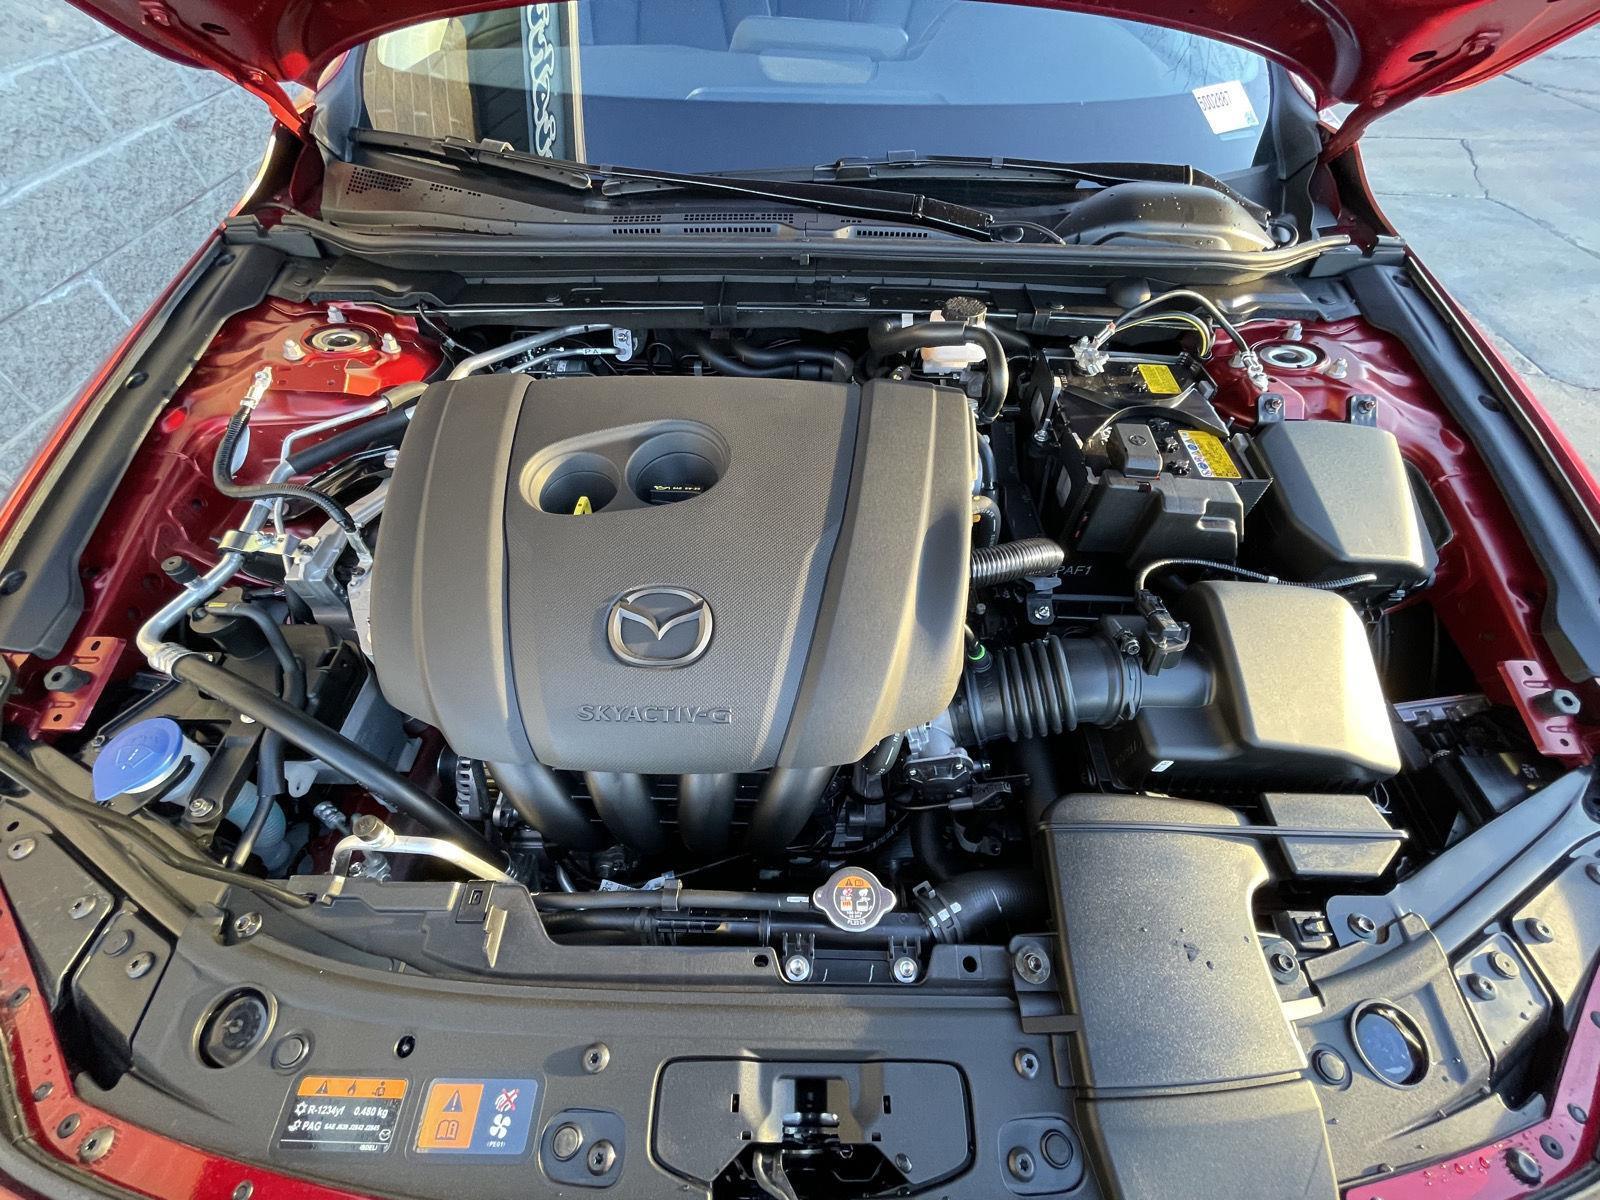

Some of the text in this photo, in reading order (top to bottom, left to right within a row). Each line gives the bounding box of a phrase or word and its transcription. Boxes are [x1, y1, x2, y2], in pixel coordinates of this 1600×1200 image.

[576, 704, 733, 724] SKYACTIV-G
[377, 1107, 389, 1118] kg
[301, 1121, 322, 1131] PAG
